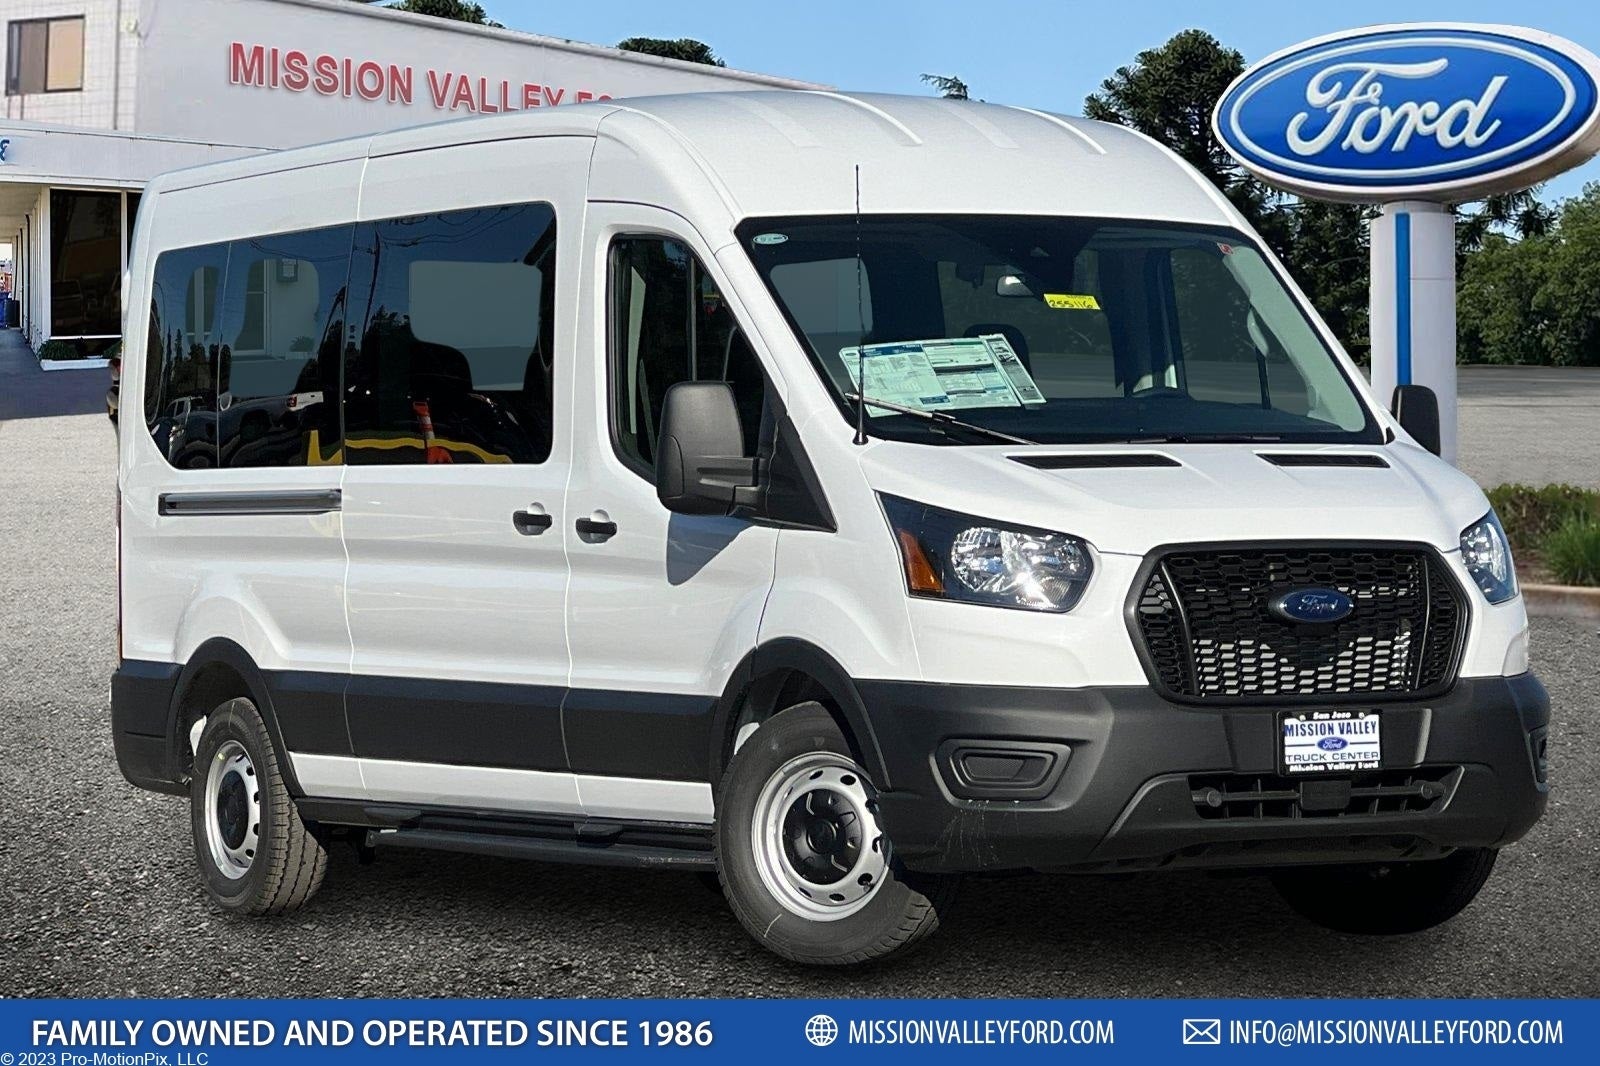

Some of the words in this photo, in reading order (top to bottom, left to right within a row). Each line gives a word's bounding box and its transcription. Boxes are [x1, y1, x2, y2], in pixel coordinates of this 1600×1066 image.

[230, 42, 414, 104] MISSION
[427, 69, 565, 113] VALLEY
[1286, 57, 1509, 156] Ford
[1298, 594, 1339, 614] Ford
[1285, 723, 1334, 736] MISSION
[1338, 721, 1377, 735] VALLEY
[1322, 738, 1343, 750] Ford
[1287, 753, 1327, 762] TRUCK
[1332, 751, 1379, 761] CENTER
